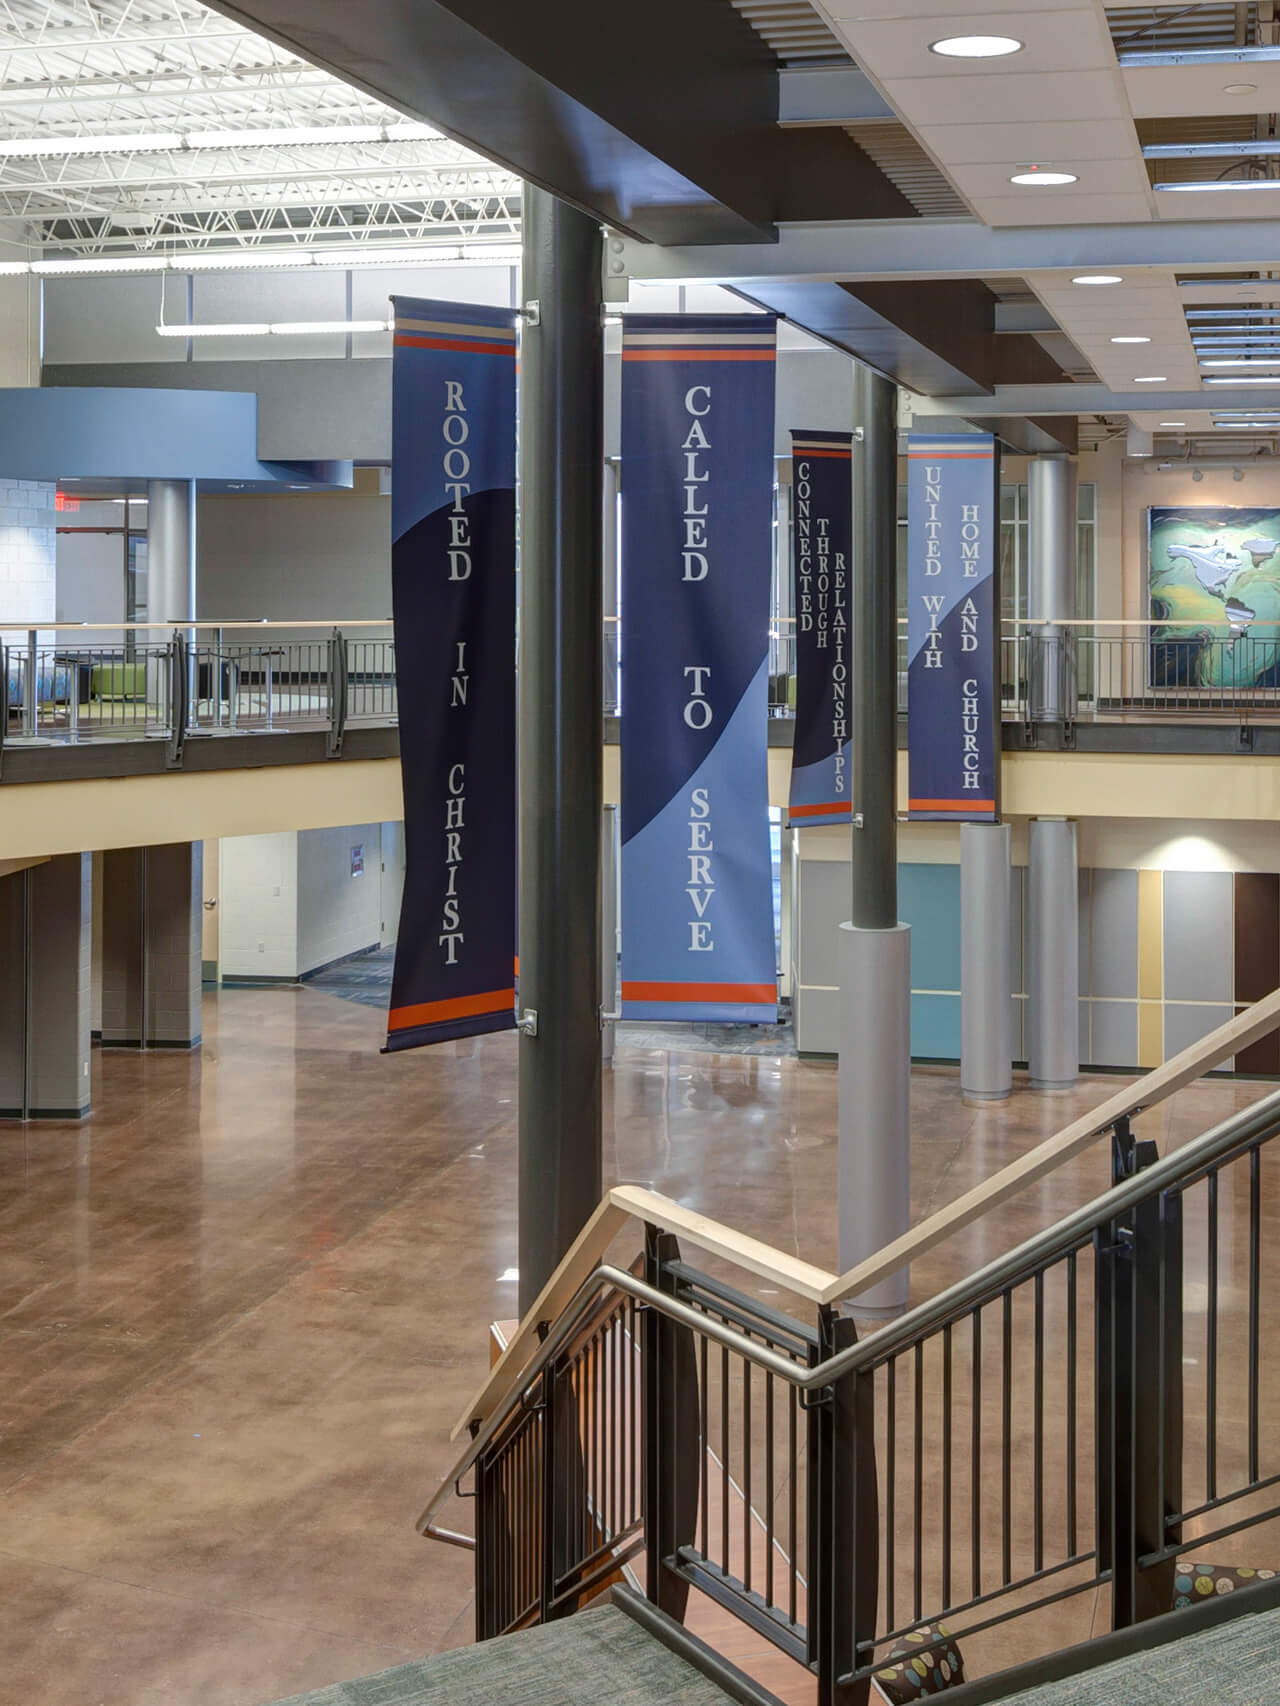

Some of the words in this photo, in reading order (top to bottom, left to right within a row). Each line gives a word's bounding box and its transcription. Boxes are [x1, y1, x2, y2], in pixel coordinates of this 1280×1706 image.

[442, 381, 472, 581] ROOTED
[681, 386, 712, 581] CALLED
[924, 466, 942, 576] UNITED
[797, 462, 813, 632] CONNECTED
[816, 518, 830, 649] THROUGH
[960, 505, 980, 578] HOME
[450, 642, 469, 707] IN
[832, 552, 848, 793] RELATIONSHIPS
[922, 595, 945, 668] WITH
[961, 598, 979, 652] AND
[683, 666, 713, 730] TO
[961, 679, 980, 789] CHURCH
[439, 763, 465, 965] CHRIST
[685, 788, 716, 951] SERVE
